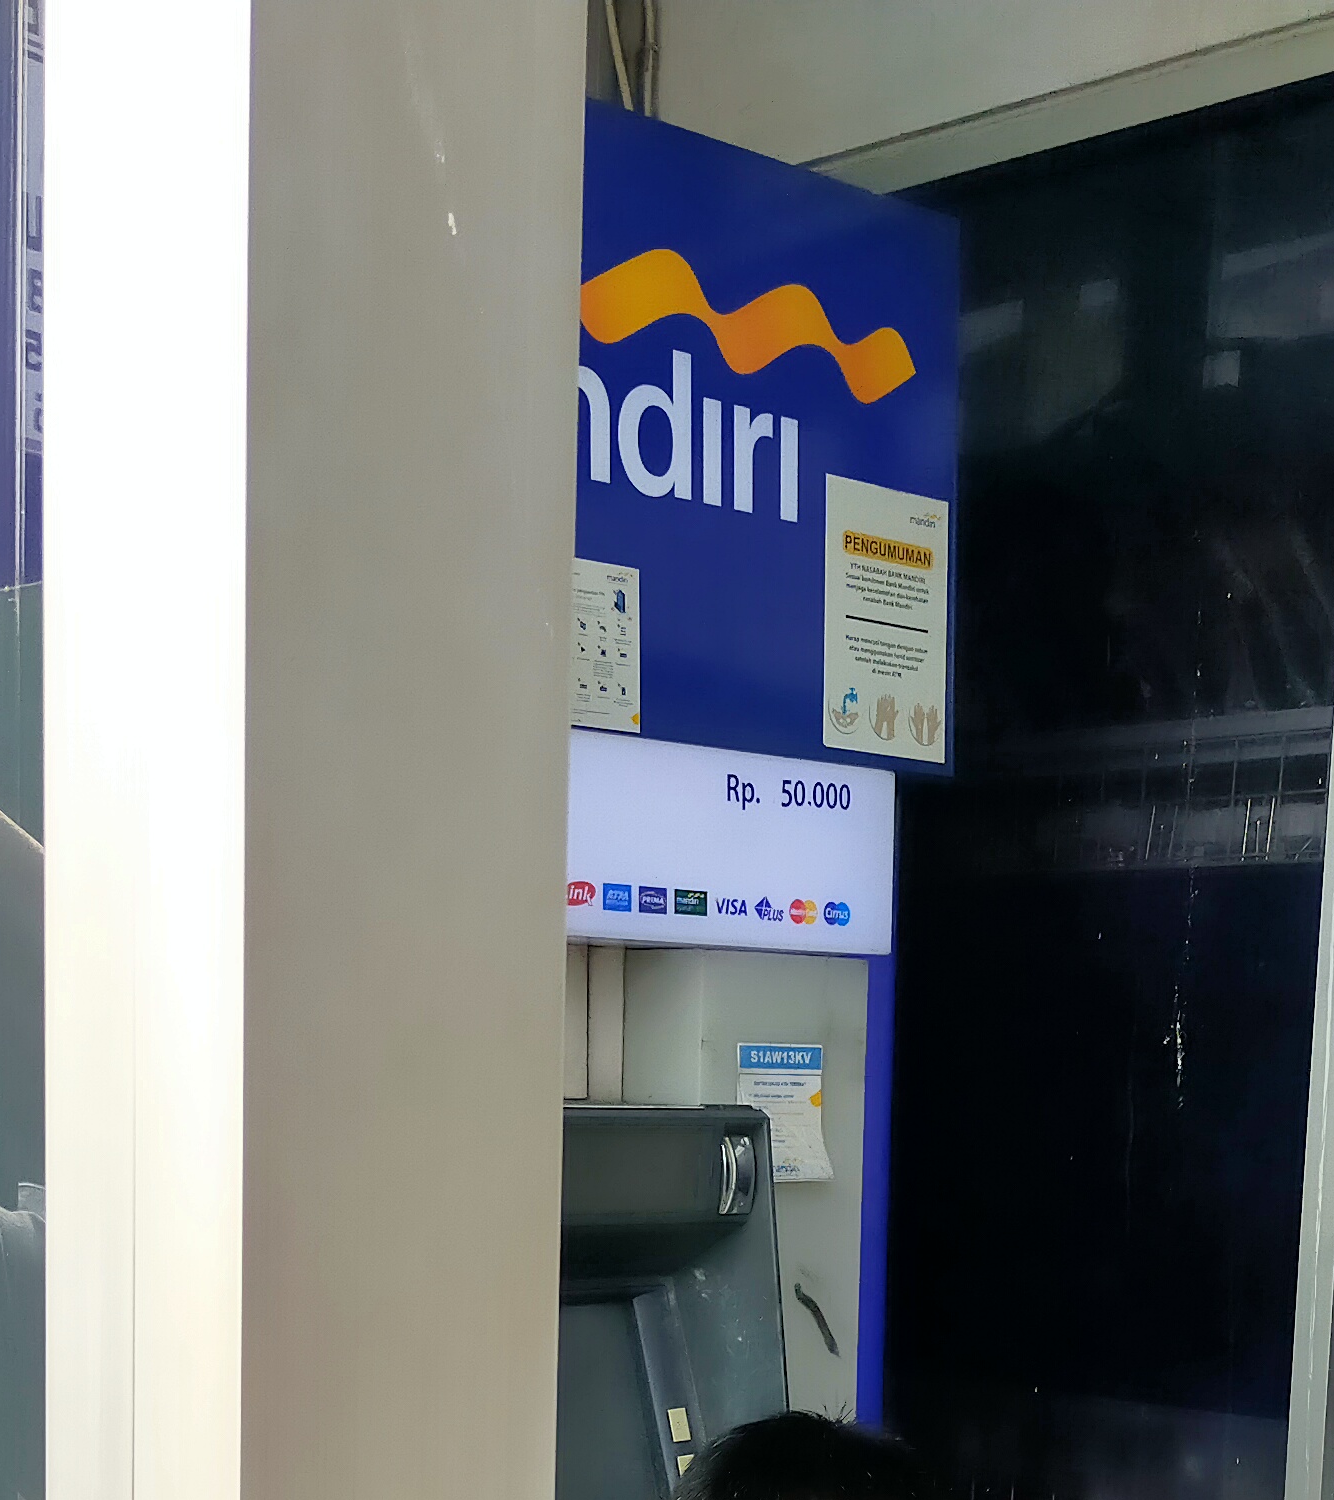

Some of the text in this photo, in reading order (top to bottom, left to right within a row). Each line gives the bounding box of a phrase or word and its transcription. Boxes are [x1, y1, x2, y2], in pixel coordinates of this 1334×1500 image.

[845, 534, 932, 567] PENGUMUMAN
[726, 773, 852, 812] Rp. 50.000
[716, 897, 748, 917] VISA
[762, 908, 785, 922] PLUS
[750, 1050, 813, 1065] S1AW13KV
